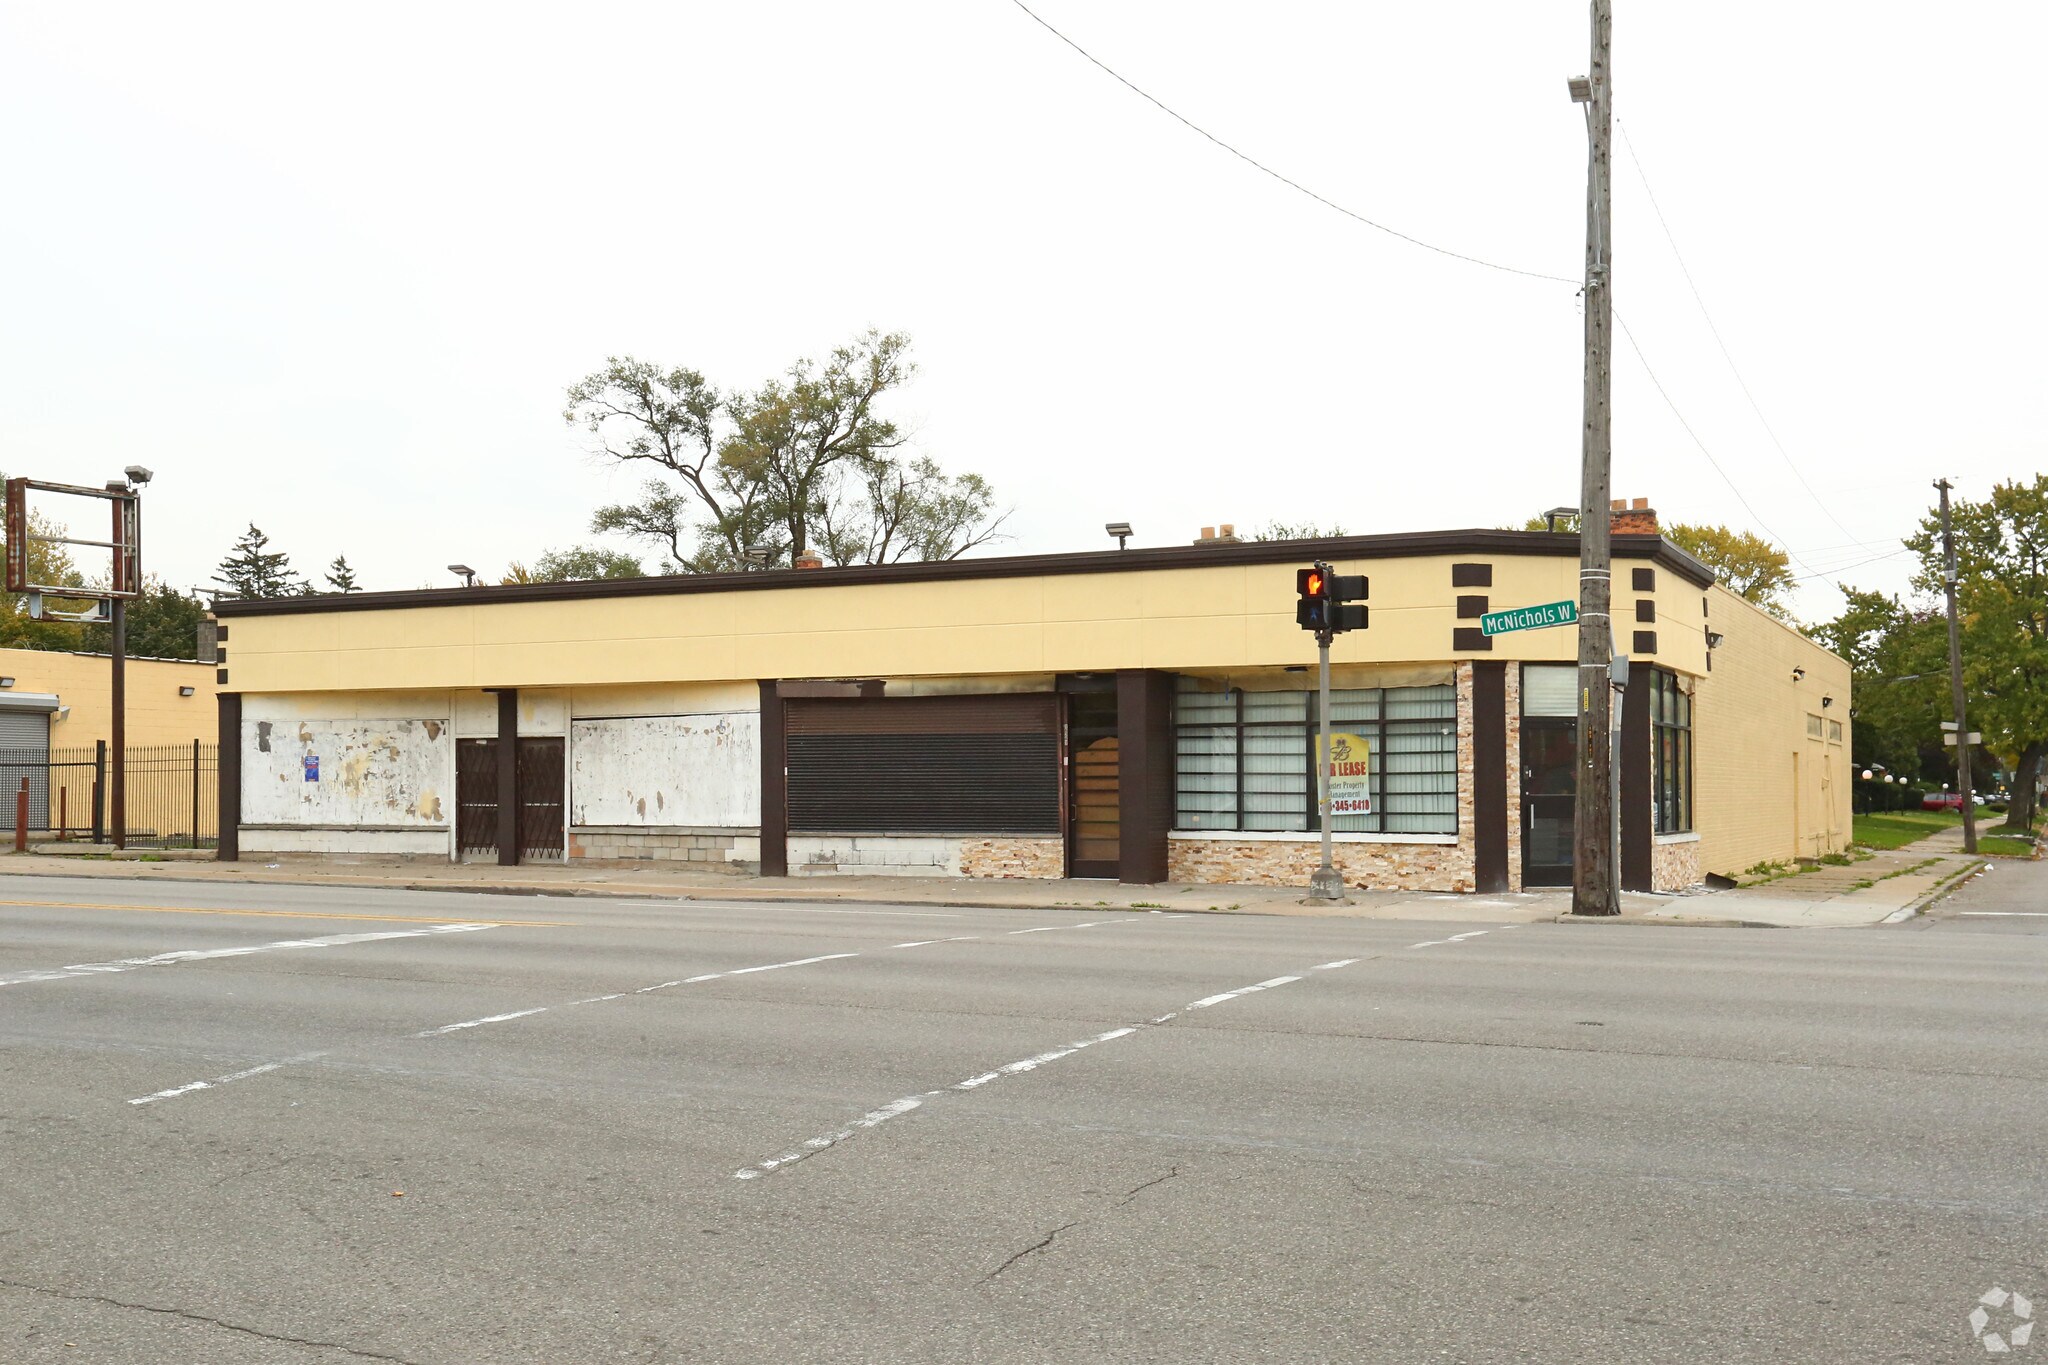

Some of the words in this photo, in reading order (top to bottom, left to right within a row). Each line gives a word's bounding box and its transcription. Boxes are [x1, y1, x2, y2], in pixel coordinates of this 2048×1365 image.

[1486, 608, 1555, 632] McNichols
[1558, 604, 1570, 620] W
[1339, 762, 1366, 776] LEASE
[1343, 782, 1364, 790] Property
